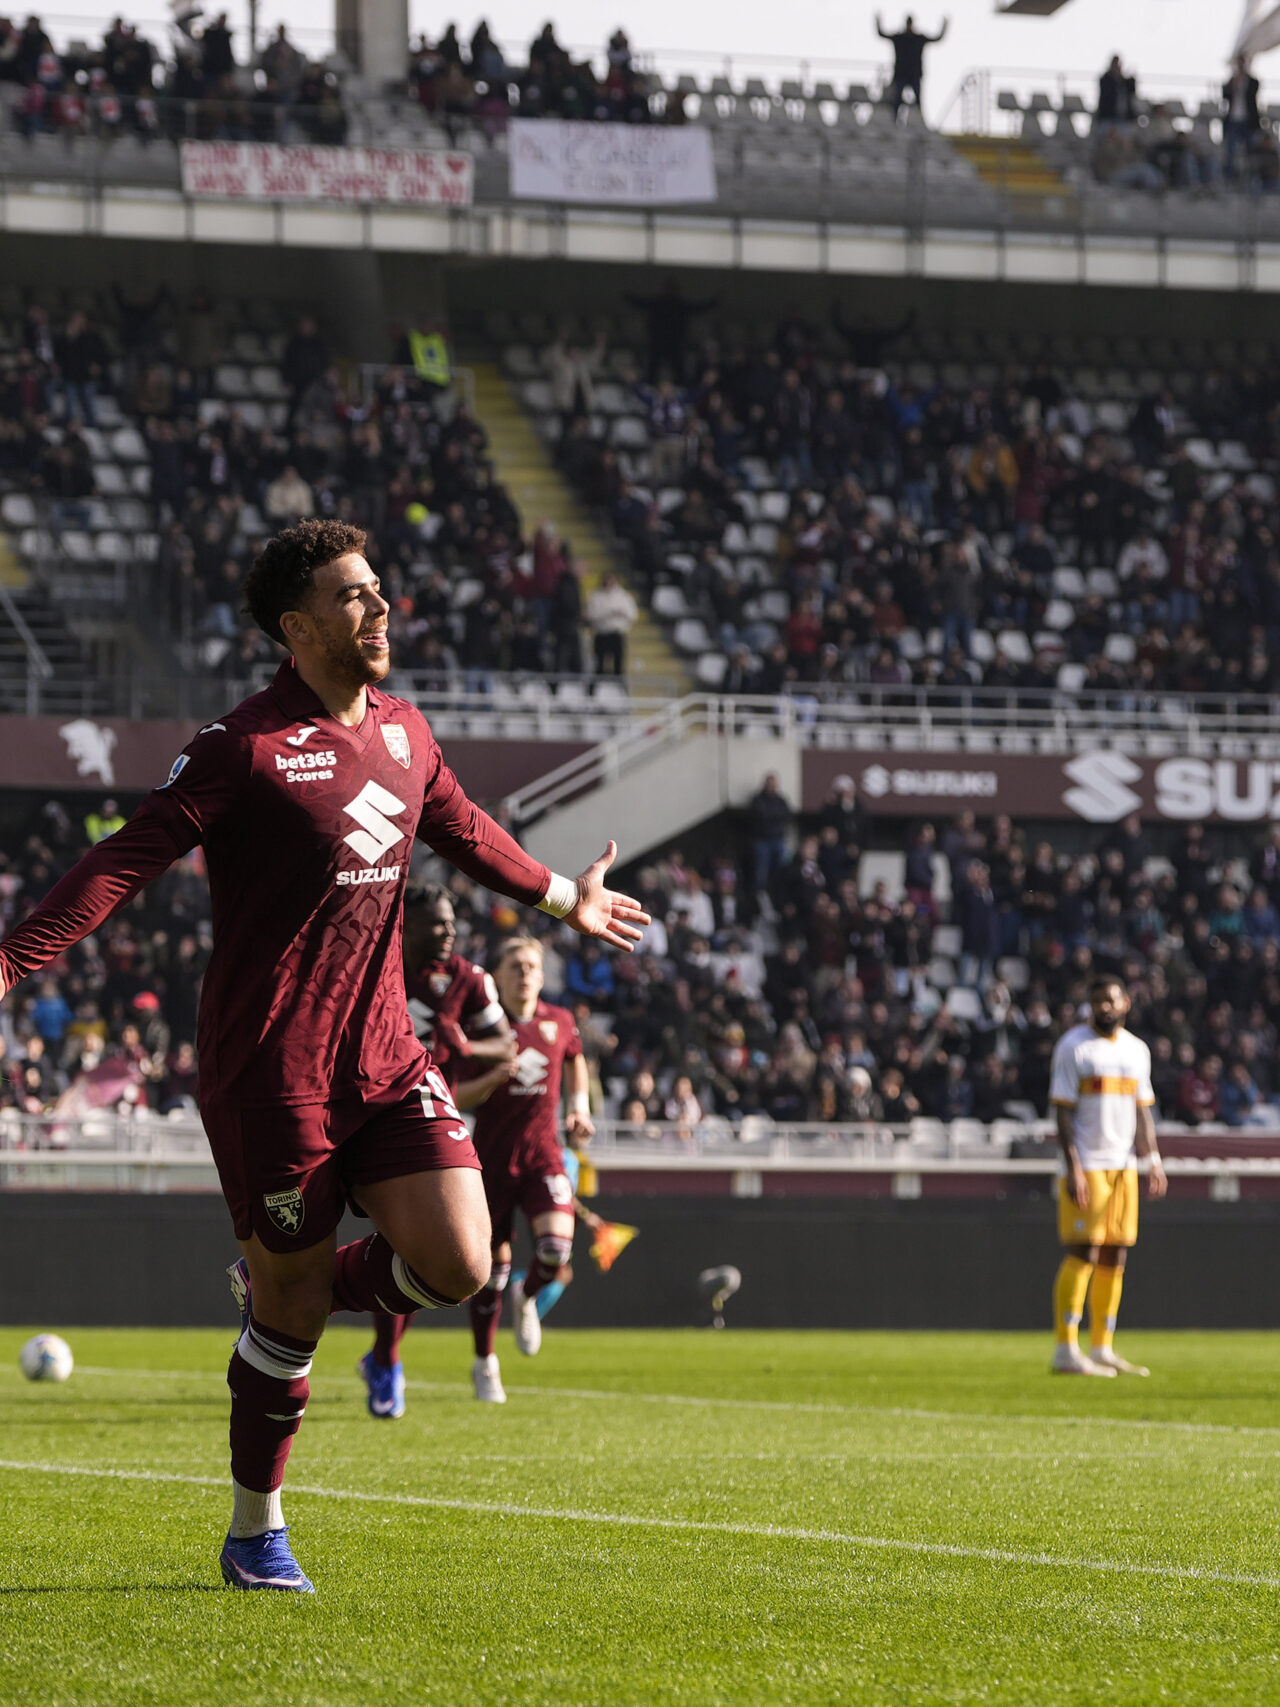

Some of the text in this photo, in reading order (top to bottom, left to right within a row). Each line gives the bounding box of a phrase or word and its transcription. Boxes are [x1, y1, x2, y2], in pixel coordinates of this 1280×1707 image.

[275, 751, 337, 770] bet365
[286, 769, 334, 783] Scores
[1154, 757, 1280, 820] SU
[336, 866, 400, 886] SUZUKI
[267, 1192, 298, 1205] TORINO
[289, 1201, 301, 1210] FC
